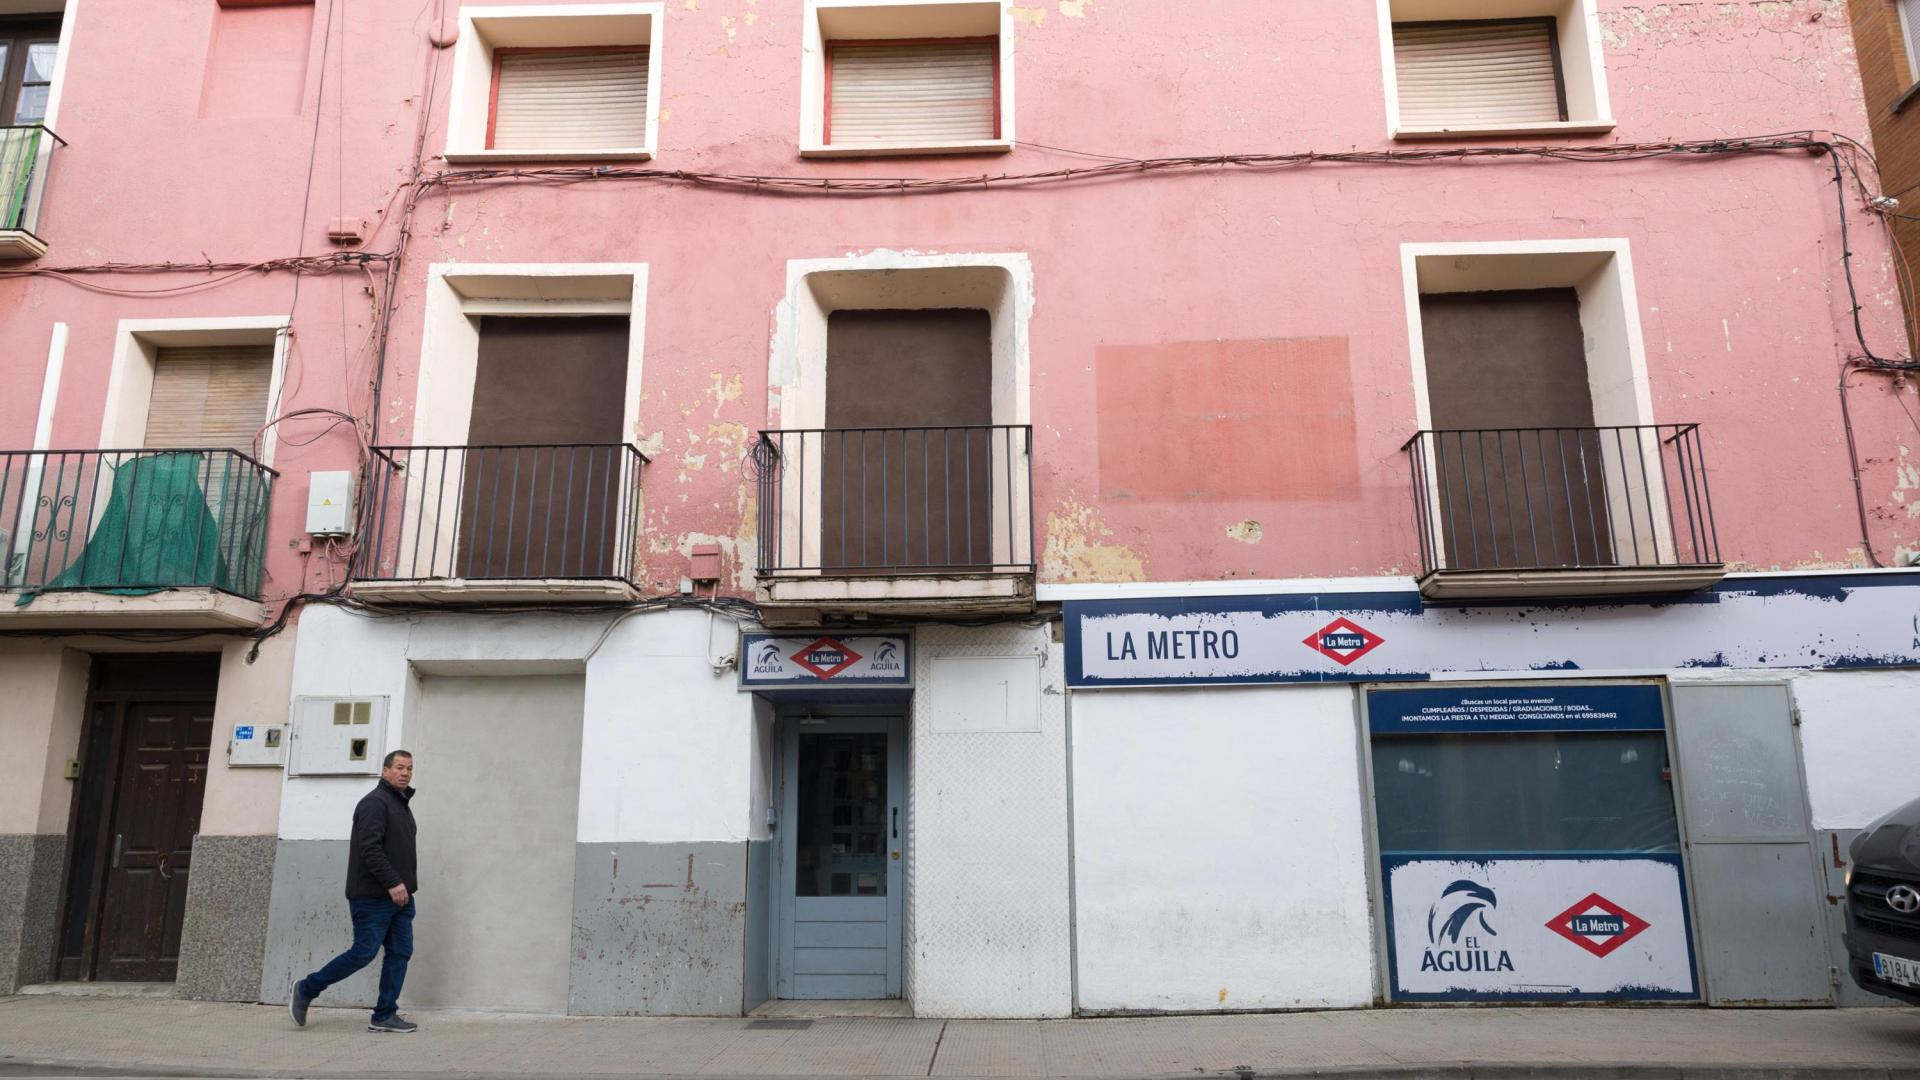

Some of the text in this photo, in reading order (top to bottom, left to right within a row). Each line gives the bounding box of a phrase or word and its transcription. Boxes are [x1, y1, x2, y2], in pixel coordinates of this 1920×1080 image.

[1106, 630, 1239, 661] LA METRO
[1326, 636, 1361, 647] La Metro
[810, 653, 842, 663] La Metro
[1576, 919, 1620, 932] La Metro
[1465, 936, 1480, 948] EL
[1420, 947, 1515, 972] ÁGUILA
[1882, 959, 1910, 980] 8184
